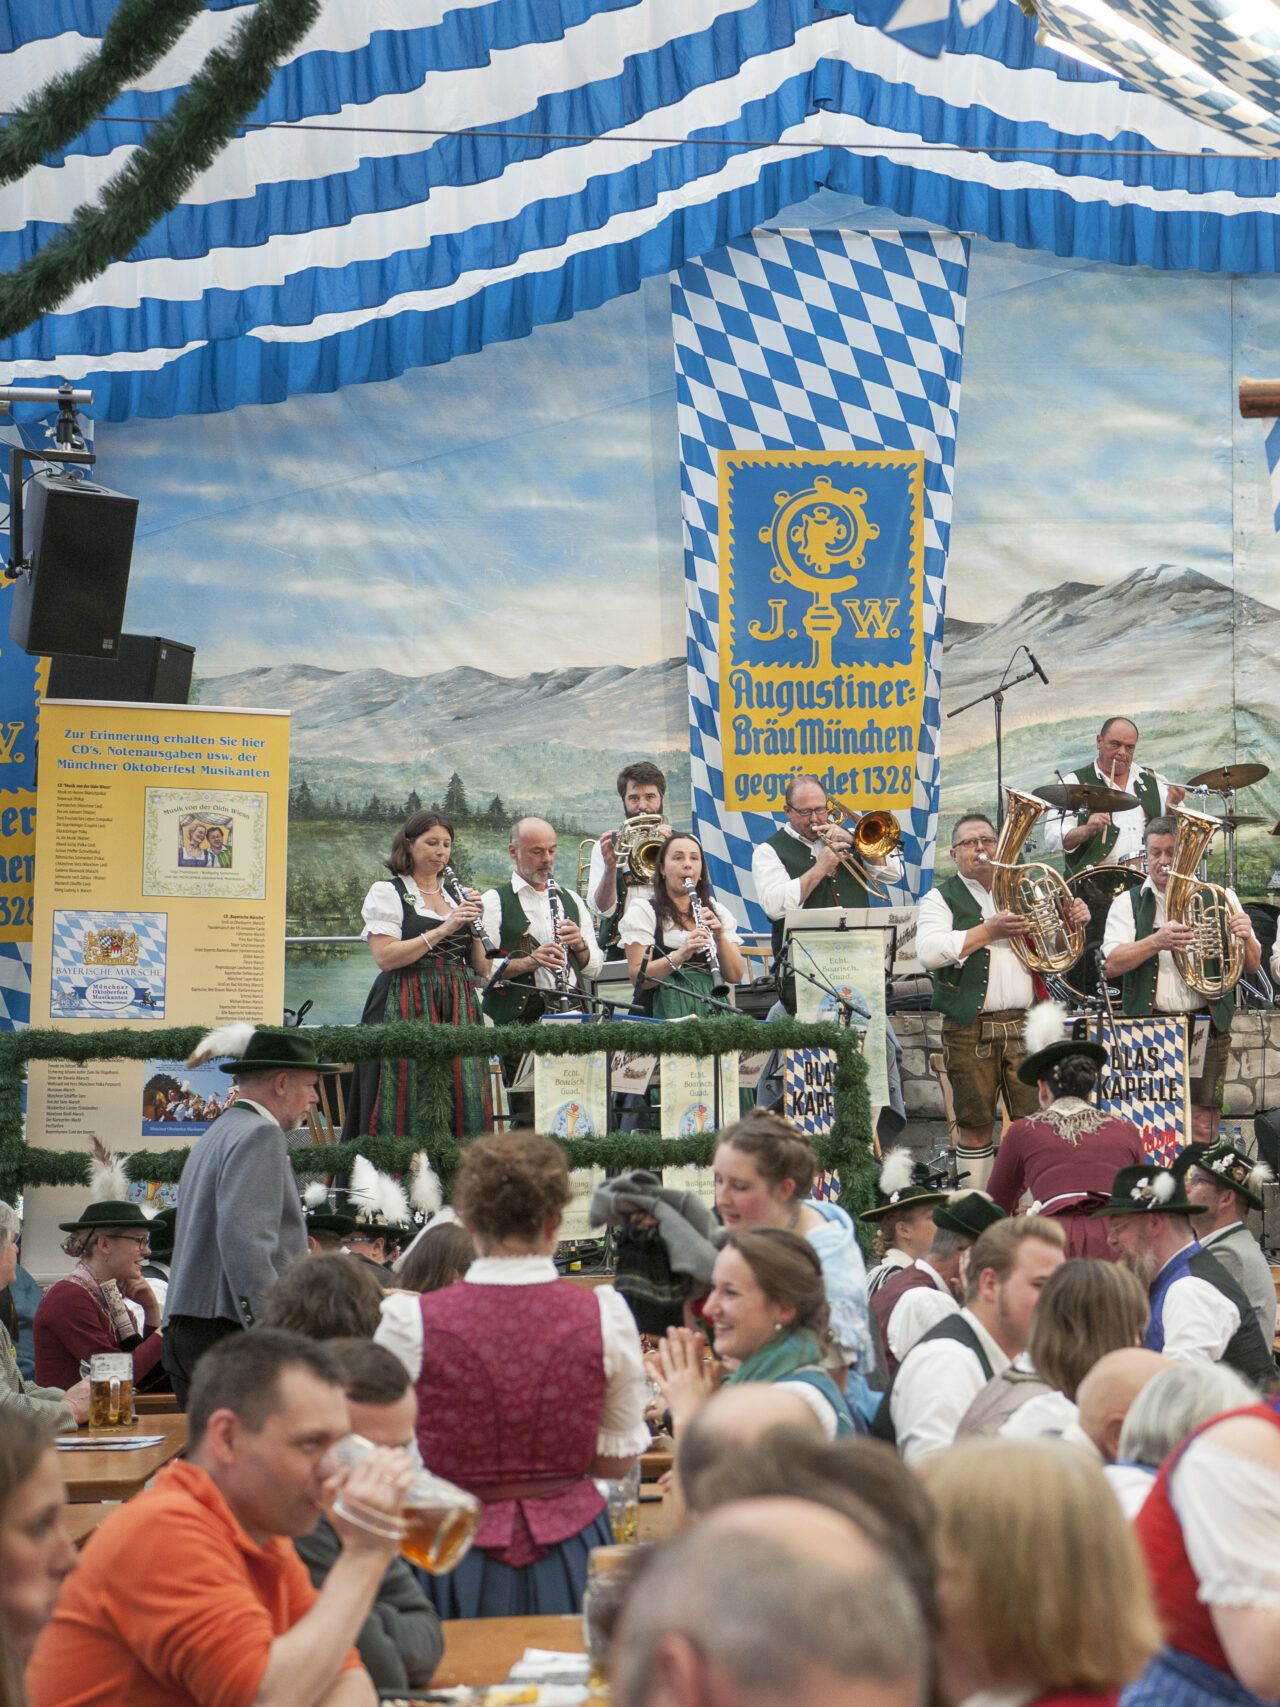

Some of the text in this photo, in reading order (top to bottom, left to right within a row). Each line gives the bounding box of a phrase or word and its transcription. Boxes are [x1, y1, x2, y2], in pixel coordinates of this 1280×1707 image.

[748, 599, 900, 641] J. W.
[64, 729, 265, 748] Zur Erinnerung erhalten Sie hier
[732, 714, 914, 756] Bräu München
[107, 746, 202, 760] Notenausgaben
[207, 751, 233, 761] usw.
[238, 752, 257, 762] der
[57, 760, 270, 778] Münchner Oktoberfest Musikanten
[863, 766, 912, 795] 1328
[163, 806, 183, 816] Musik
[56, 967, 162, 977] BAYERISCHE MÄRSCHE
[561, 1087, 581, 1095] Guad.
[1099, 1076, 1178, 1102] KAPELLE
